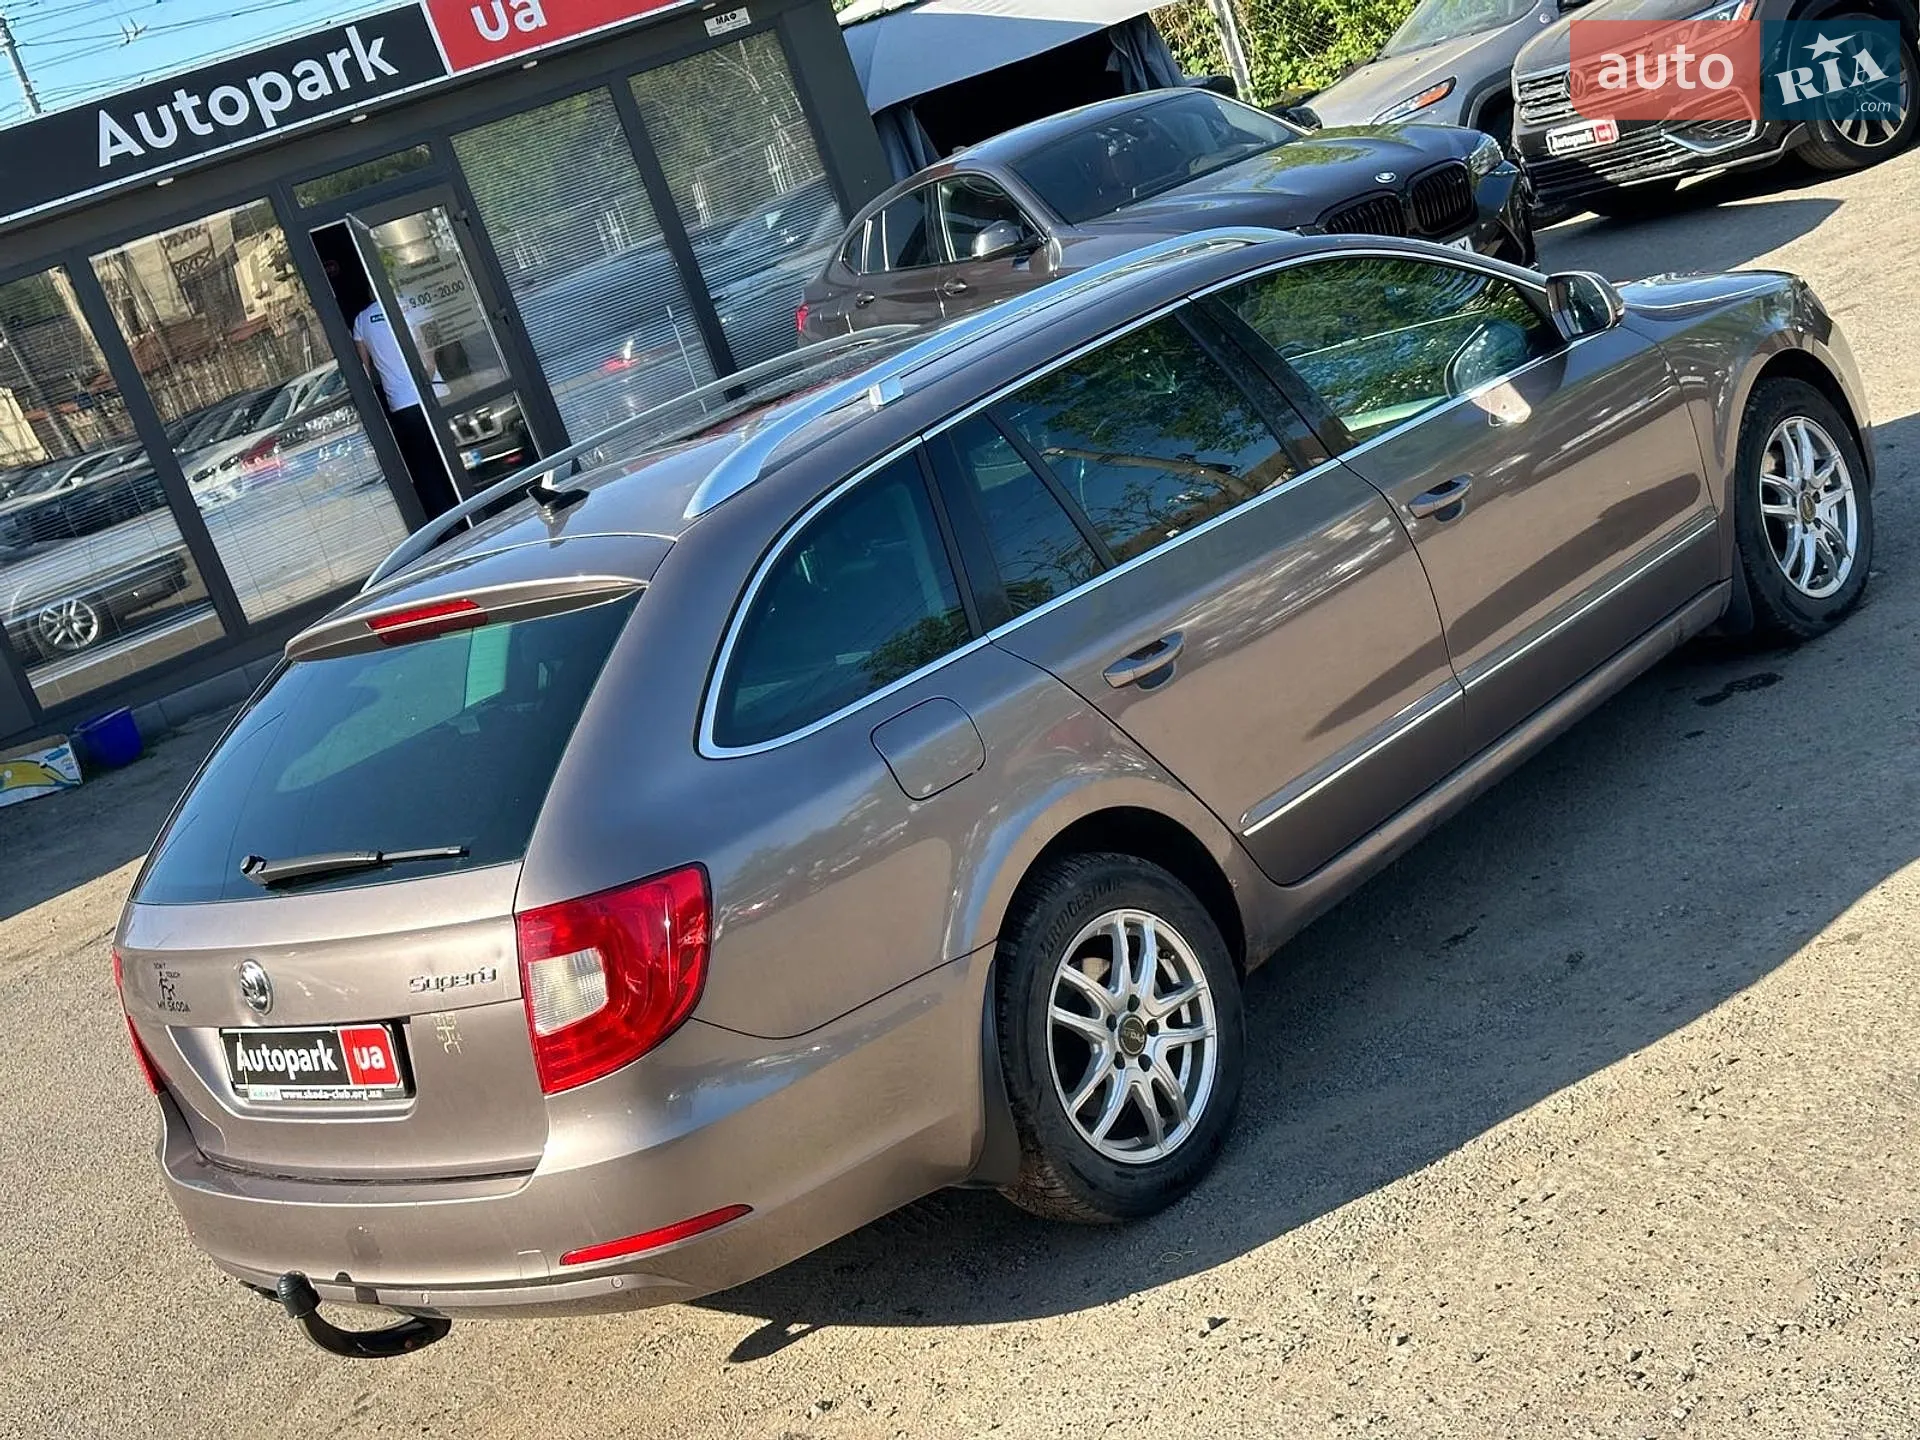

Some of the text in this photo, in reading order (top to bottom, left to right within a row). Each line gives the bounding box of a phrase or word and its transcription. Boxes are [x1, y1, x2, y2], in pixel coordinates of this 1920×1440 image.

[98, 0, 548, 167] Autopark ua
[1551, 129, 1595, 151] Autopark
[408, 291, 432, 308] 9.00
[439, 280, 465, 298] 20.00
[409, 967, 497, 993] Superb
[236, 1039, 387, 1081] Autopark ua
